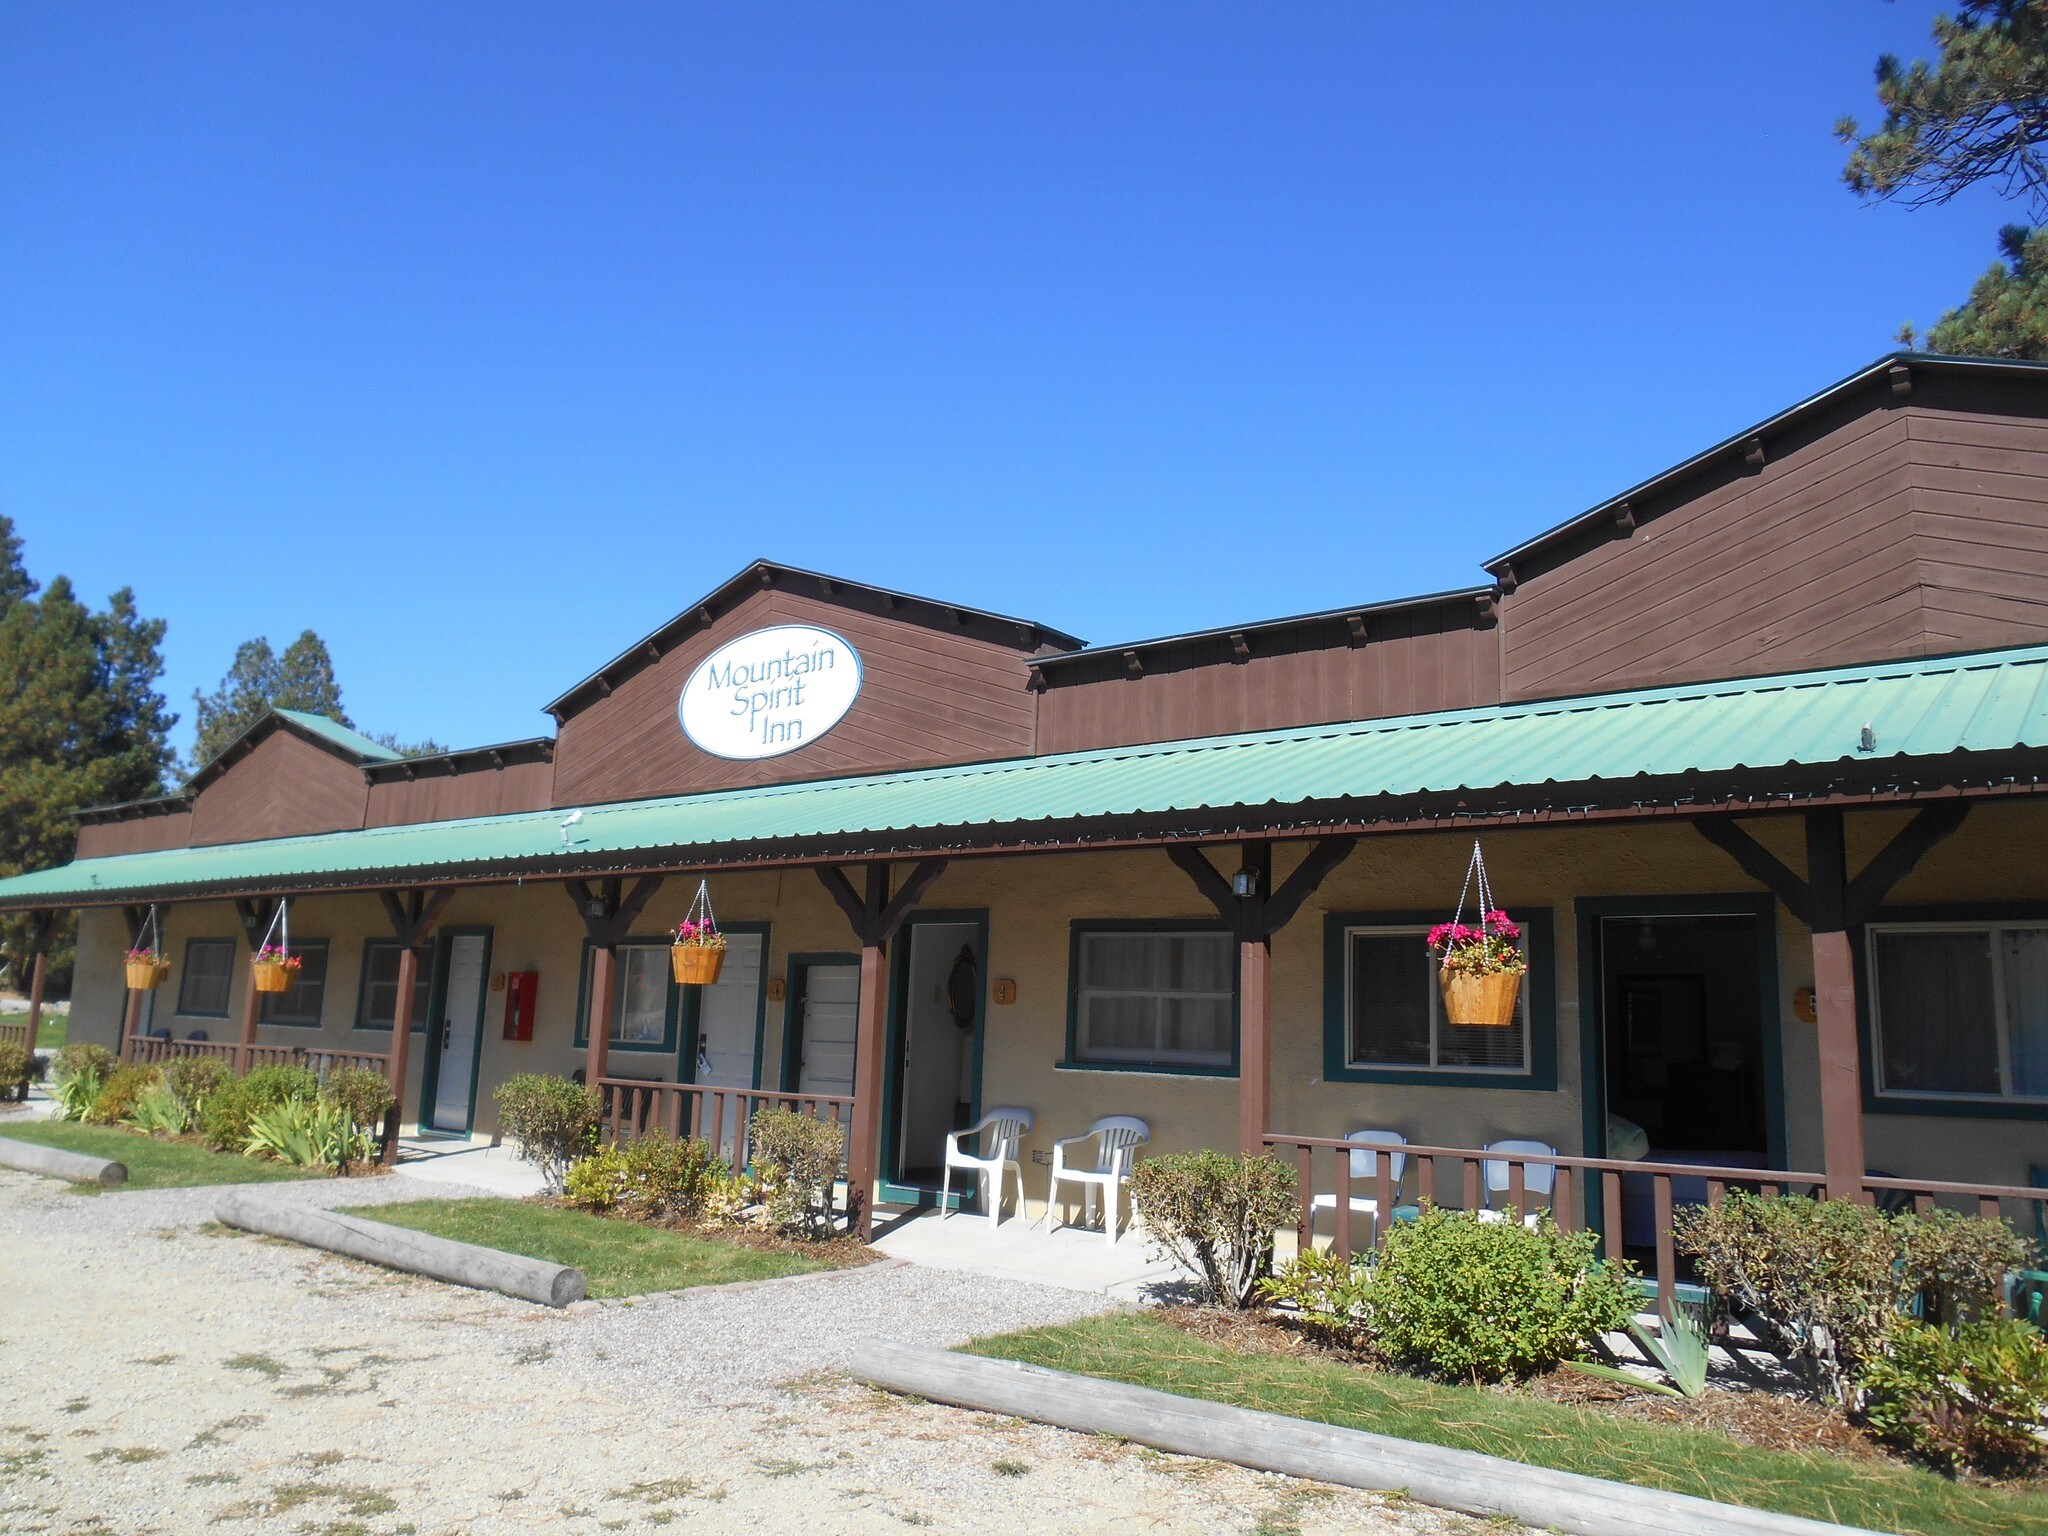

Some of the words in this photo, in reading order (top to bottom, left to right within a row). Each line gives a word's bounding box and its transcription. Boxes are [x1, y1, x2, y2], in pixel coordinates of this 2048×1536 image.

[708, 640, 834, 691] Mountain
[730, 675, 806, 733] Spirit
[762, 714, 803, 744] Inn
